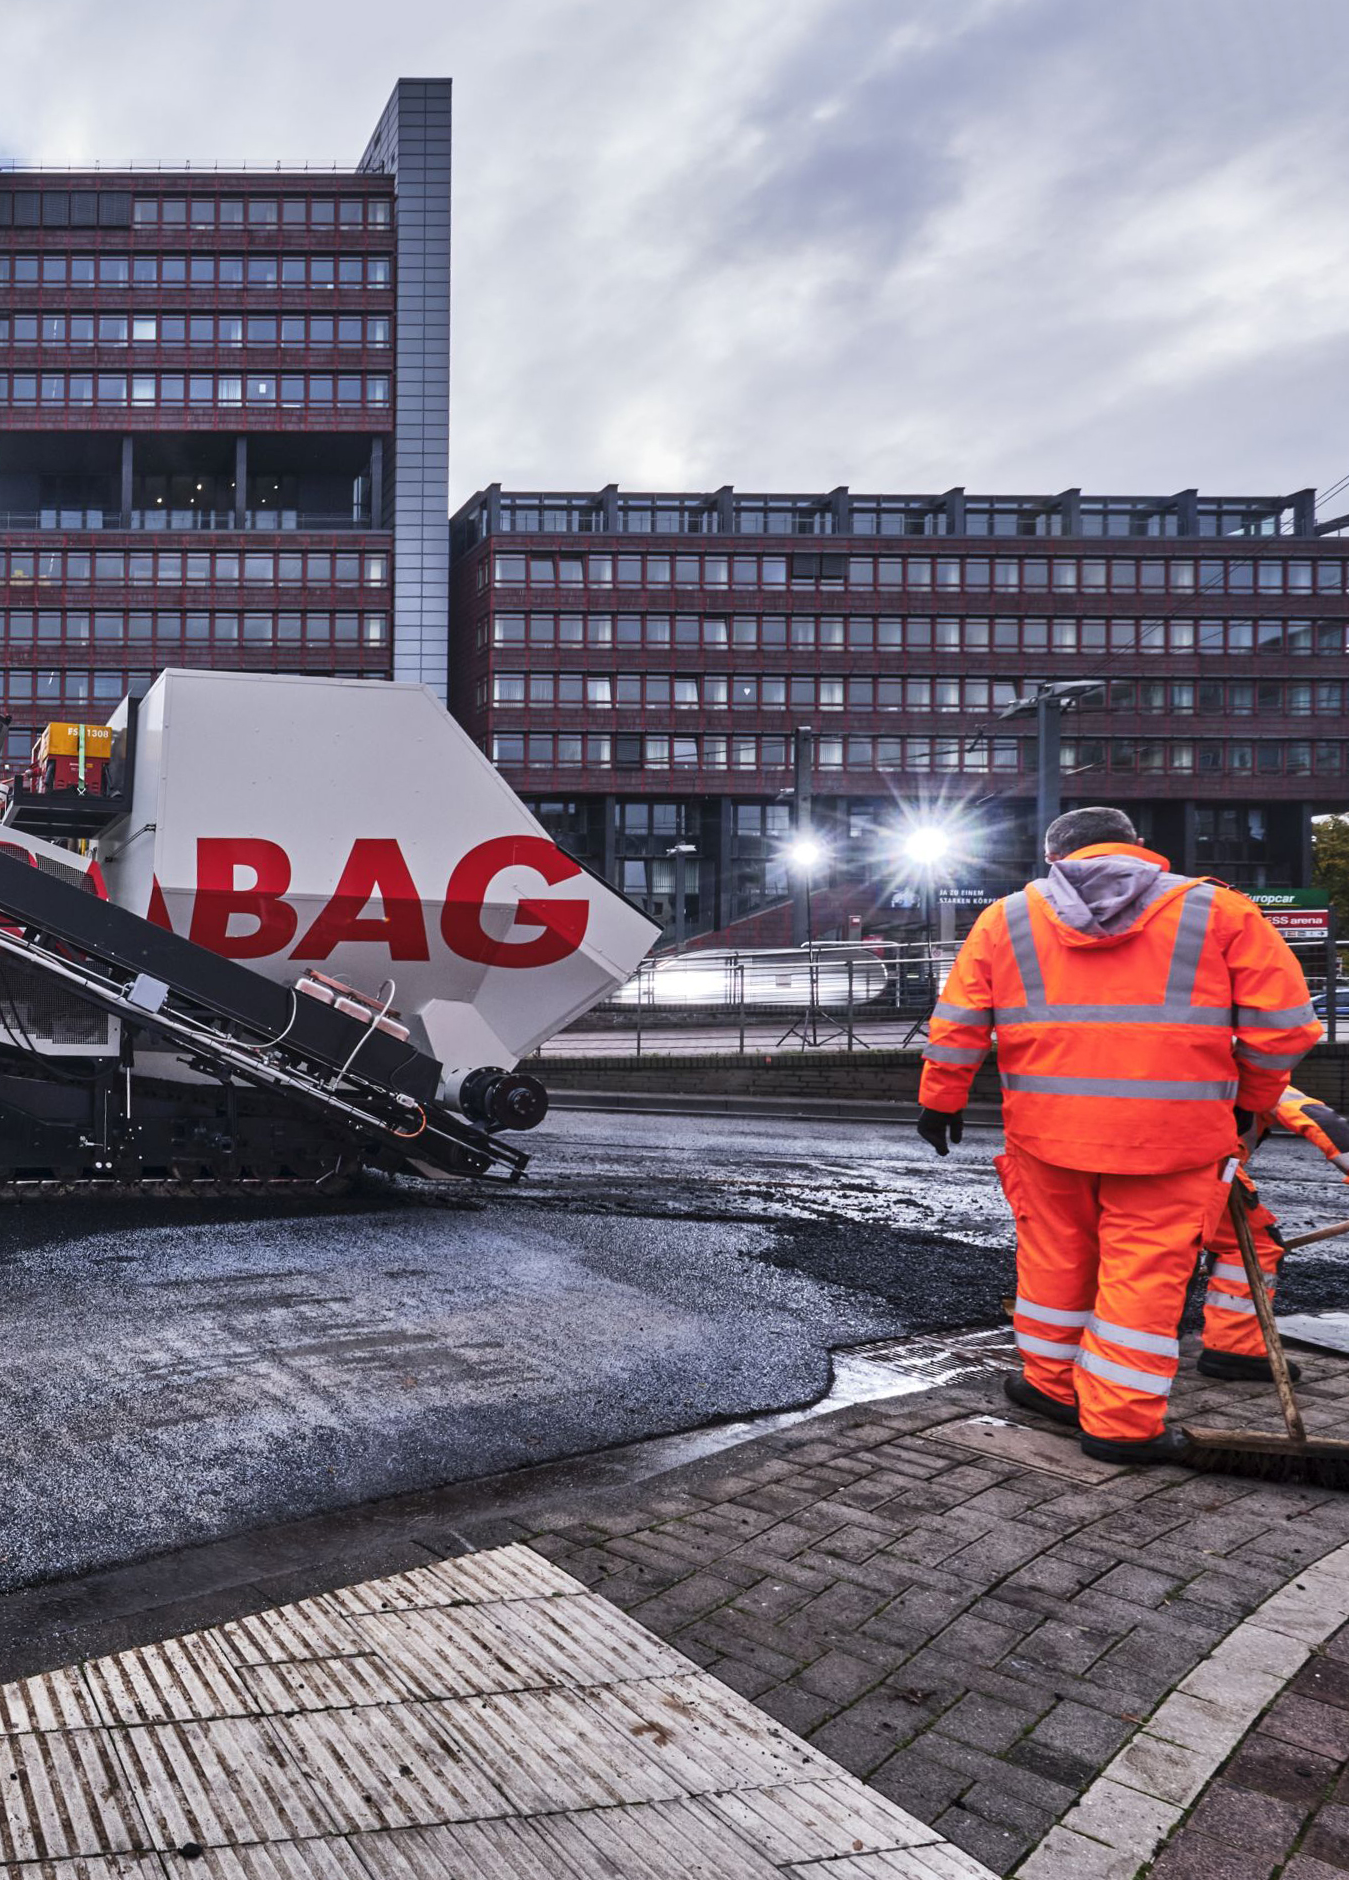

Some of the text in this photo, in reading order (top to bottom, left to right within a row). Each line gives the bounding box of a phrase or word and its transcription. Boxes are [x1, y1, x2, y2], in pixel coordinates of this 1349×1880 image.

[87, 729, 109, 738] 1308
[1244, 893, 1295, 905] uropcar
[1290, 917, 1323, 925] arena
